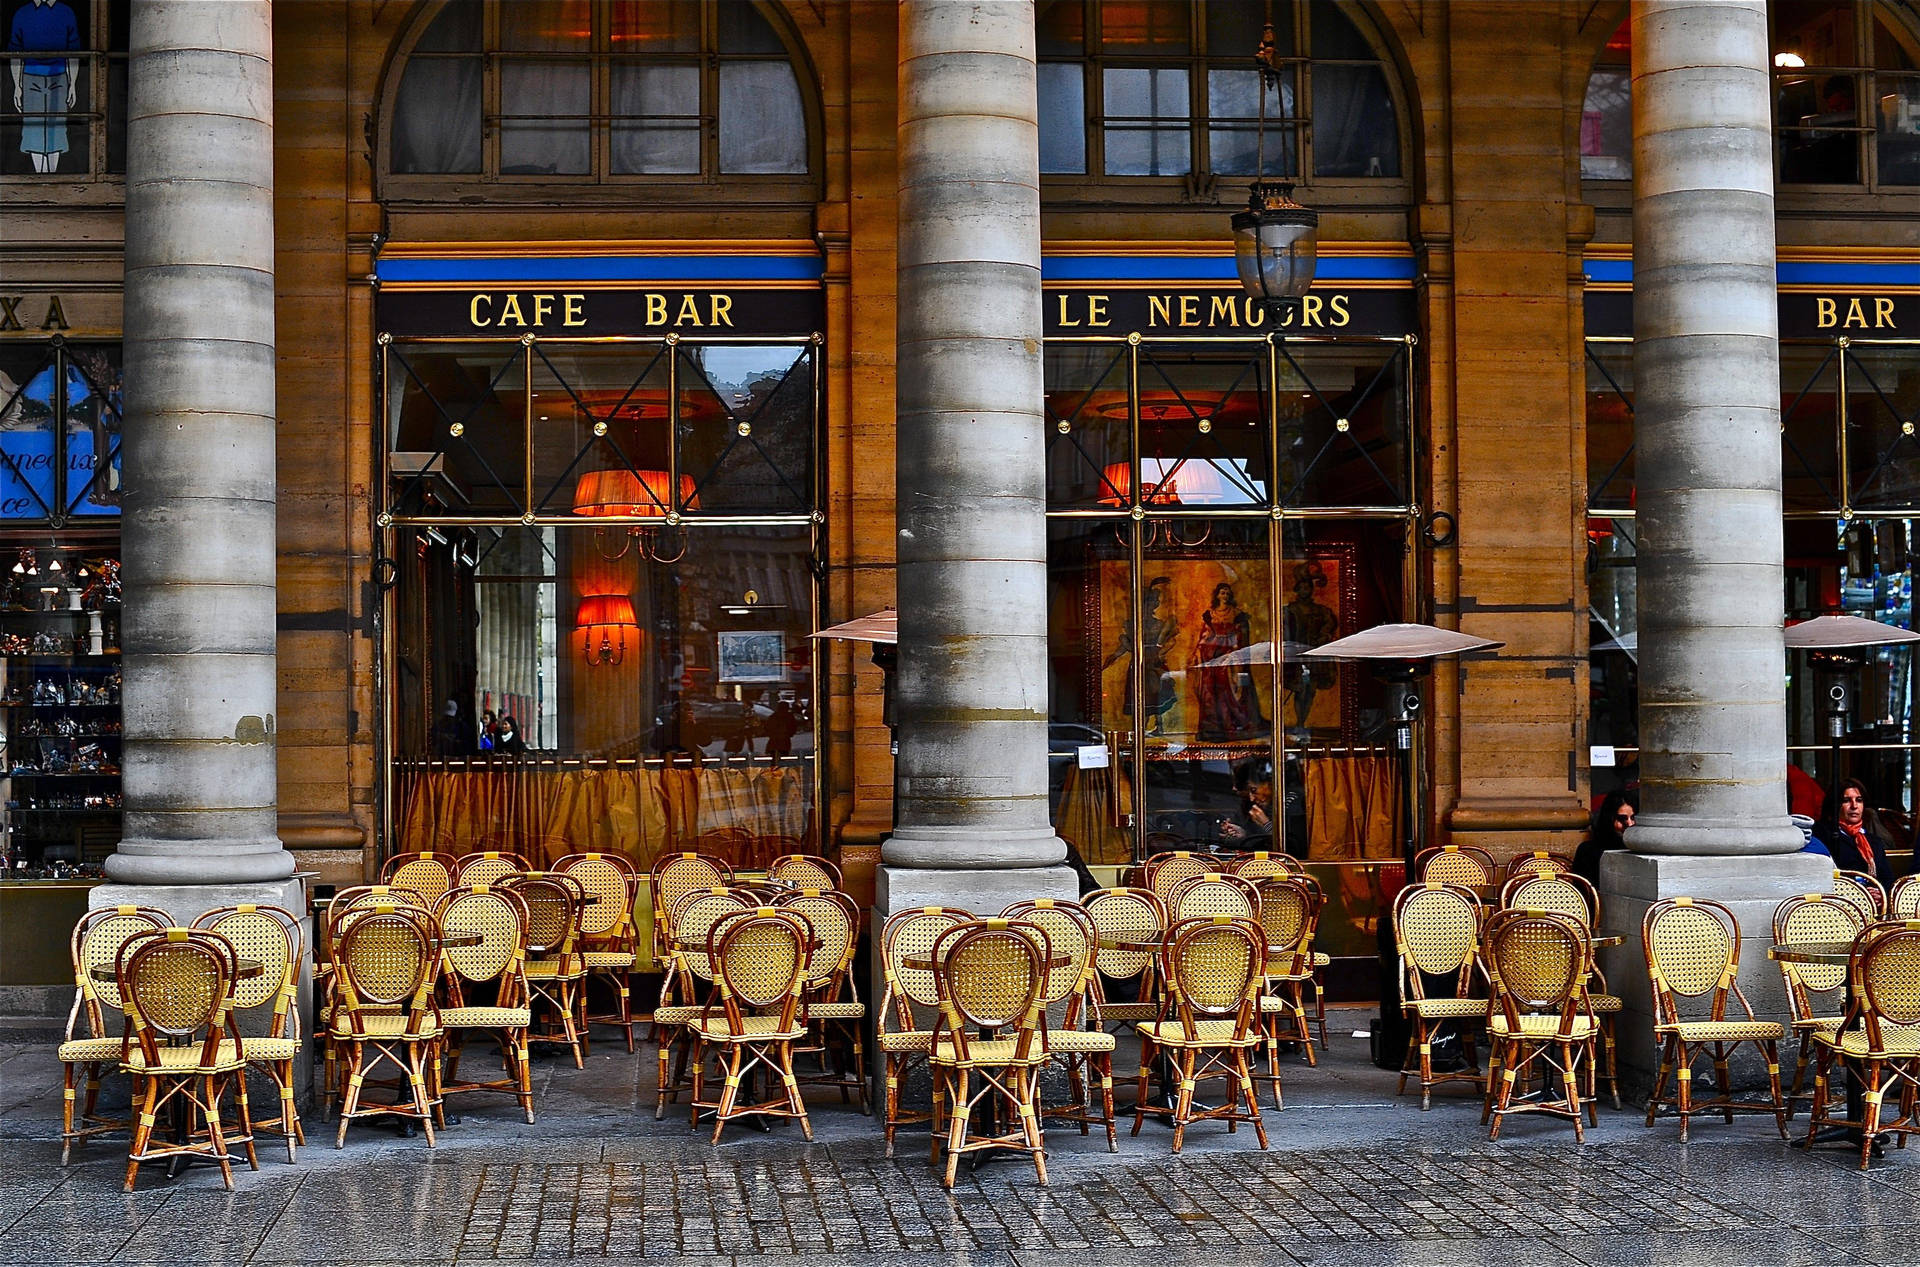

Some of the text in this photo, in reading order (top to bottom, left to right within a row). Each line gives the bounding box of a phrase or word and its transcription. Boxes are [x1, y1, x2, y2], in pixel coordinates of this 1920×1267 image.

[469, 294, 735, 327] CAFE BAR
[1058, 294, 1112, 327] LE
[1816, 297, 1897, 329] BAR
